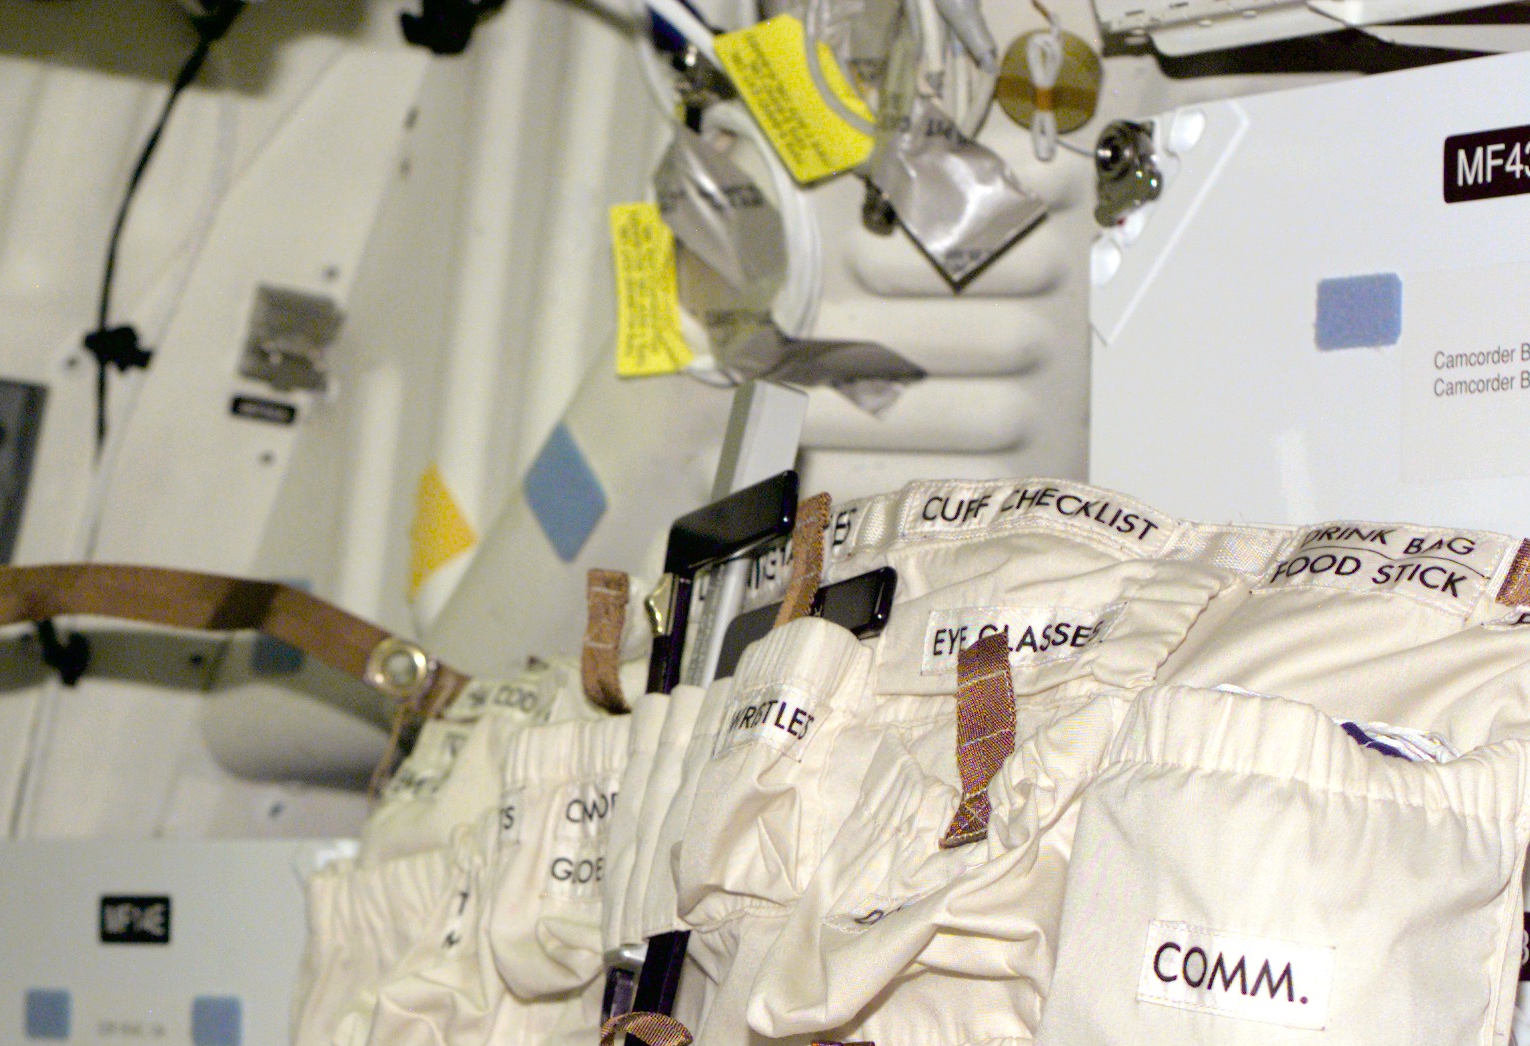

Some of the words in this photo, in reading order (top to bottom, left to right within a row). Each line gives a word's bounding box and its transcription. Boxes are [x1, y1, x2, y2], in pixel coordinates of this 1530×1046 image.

[1434, 346, 1516, 371] Camcorder
[1434, 374, 1516, 398] Camcorder
[922, 494, 992, 524] CUFF
[1000, 487, 1159, 541] CHECKLIST
[1301, 526, 1396, 549] DRINK
[1402, 537, 1476, 556] BAG
[1270, 554, 1361, 584] FOOD
[1372, 563, 1468, 598] STICK
[1153, 941, 1309, 1005] COMM.
